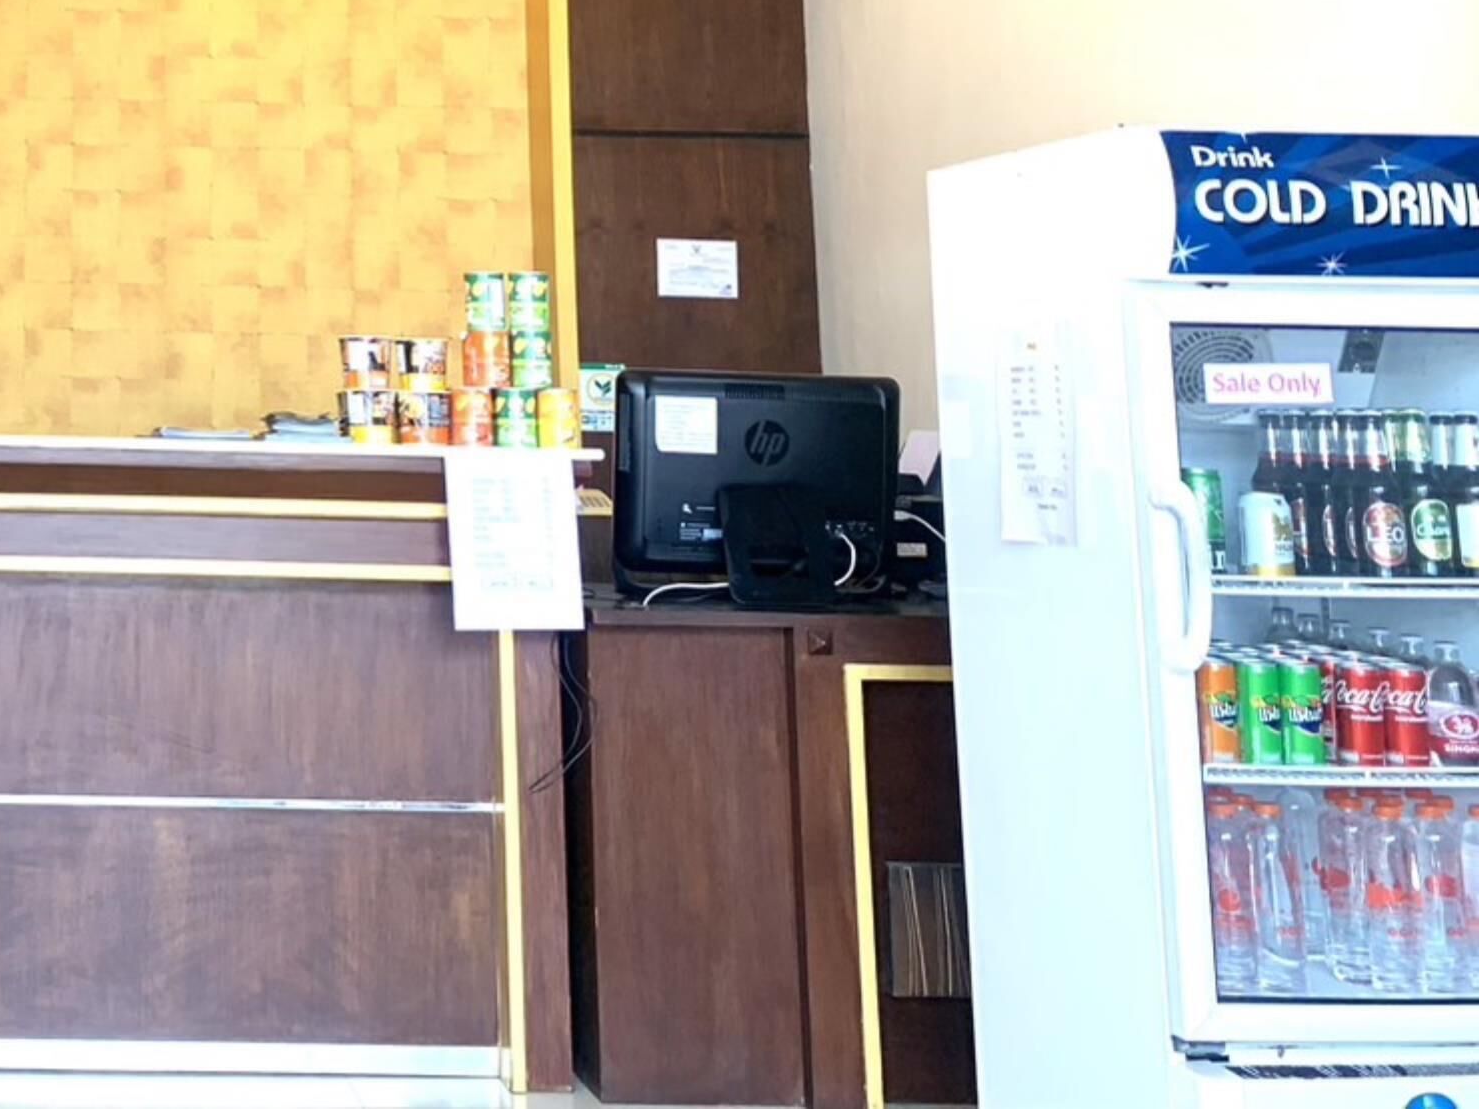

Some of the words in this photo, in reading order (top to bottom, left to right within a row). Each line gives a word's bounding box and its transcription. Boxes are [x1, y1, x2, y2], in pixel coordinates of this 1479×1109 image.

[1190, 145, 1275, 169] Drink
[1194, 178, 1327, 225] COLD
[1212, 372, 1262, 394] Sale
[1267, 373, 1322, 398] Only
[749, 420, 788, 466] hp
[1367, 525, 1405, 543] LEO
